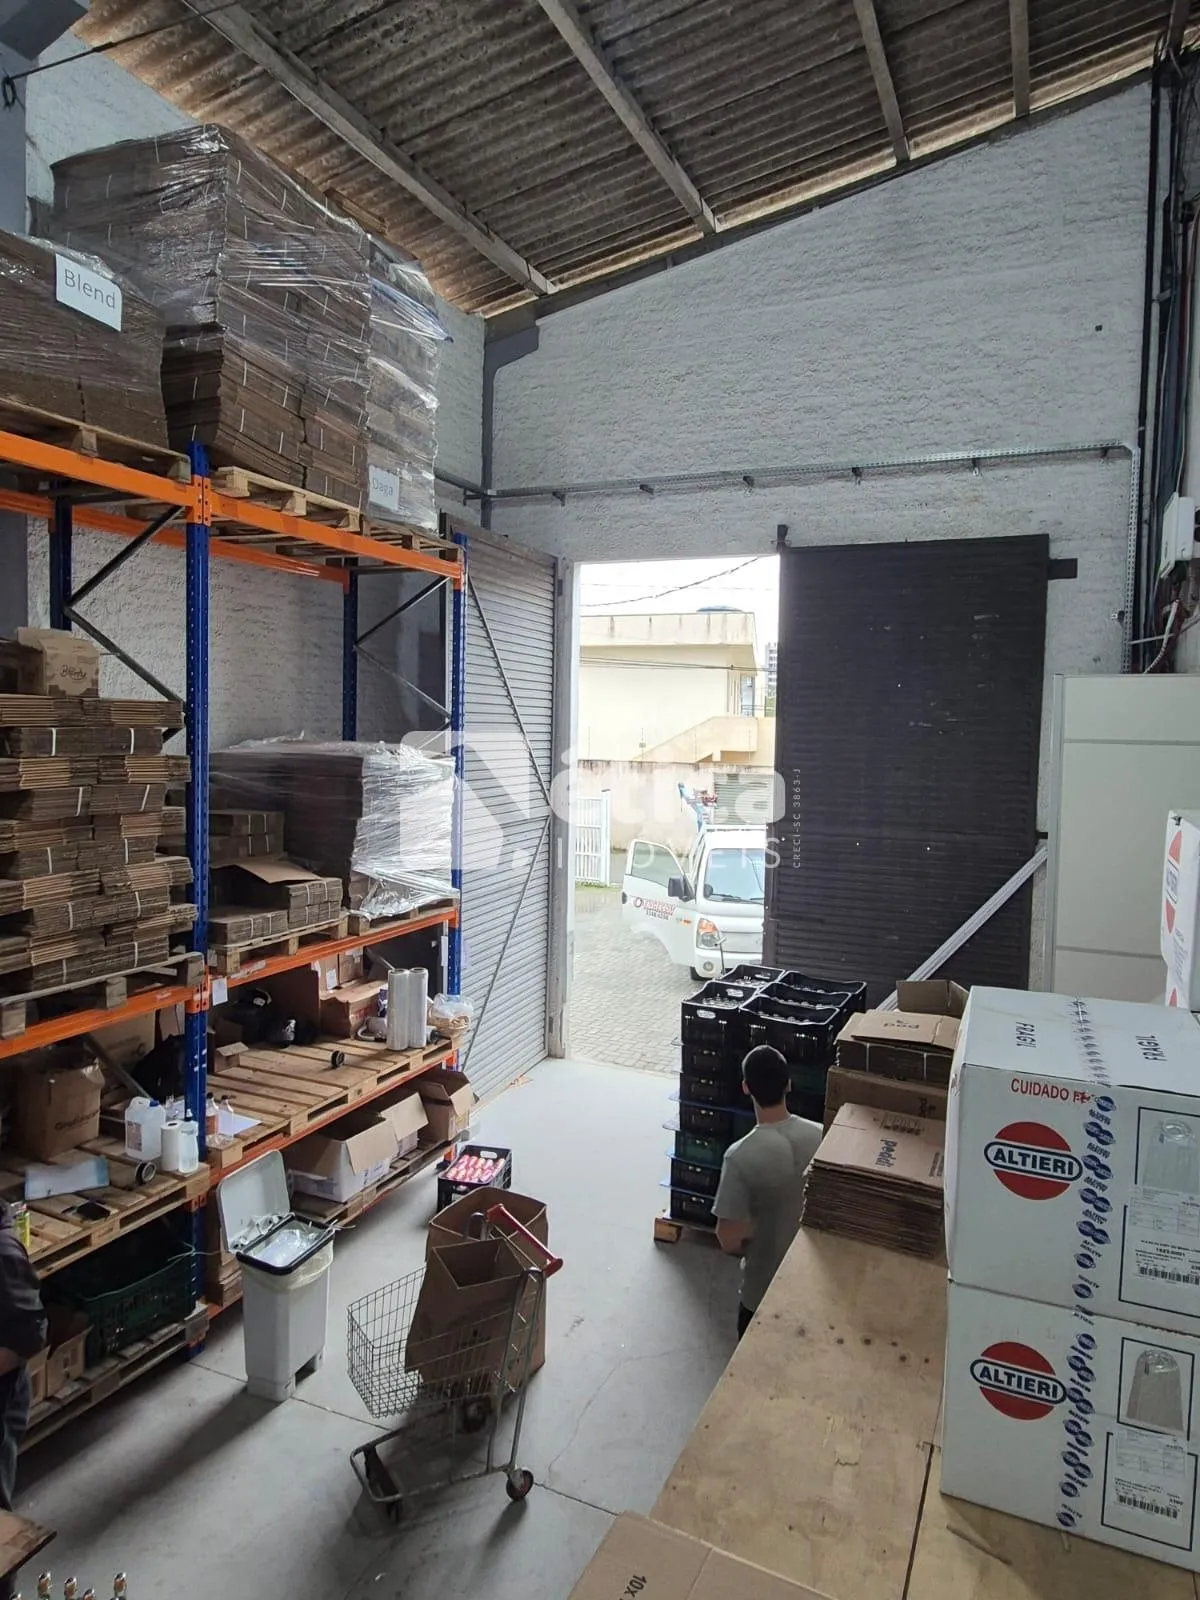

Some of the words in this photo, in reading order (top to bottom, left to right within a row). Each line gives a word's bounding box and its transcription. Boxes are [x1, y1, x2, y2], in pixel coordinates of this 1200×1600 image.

[64, 268, 116, 310] Blend
[1010, 1077, 1070, 1101] CUIDADO
[992, 1147, 1075, 1176] ALTIERI
[979, 1365, 1059, 1400] ALTIERI
